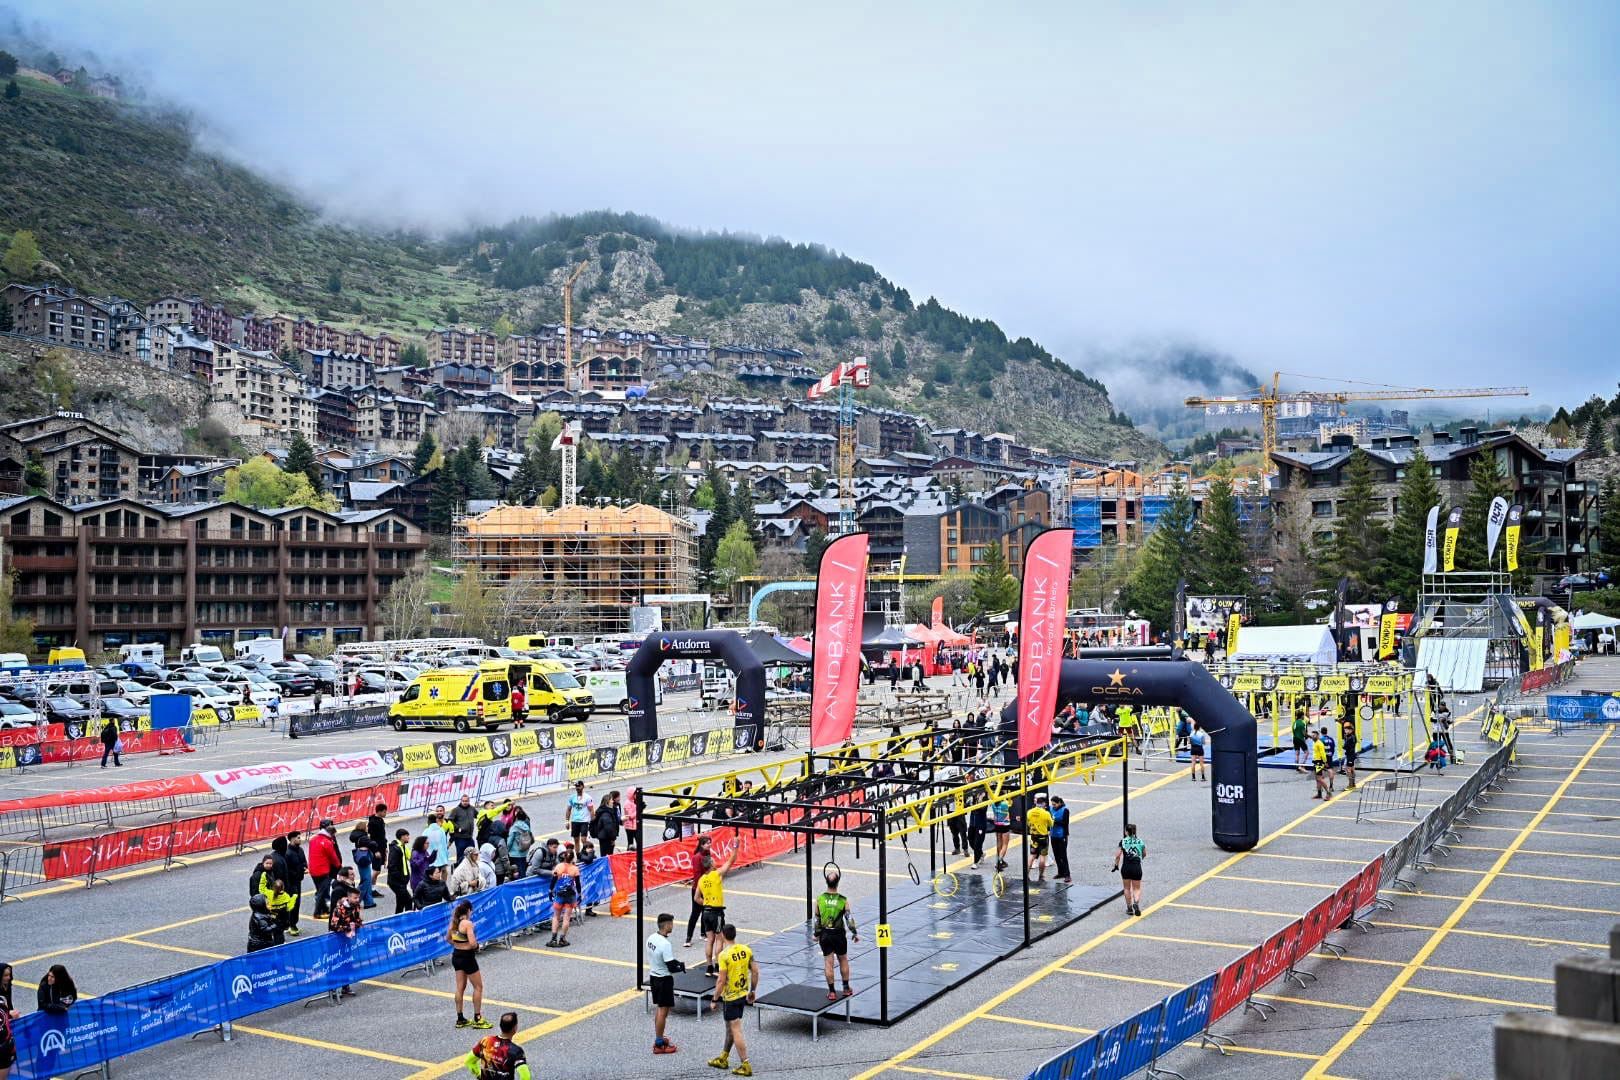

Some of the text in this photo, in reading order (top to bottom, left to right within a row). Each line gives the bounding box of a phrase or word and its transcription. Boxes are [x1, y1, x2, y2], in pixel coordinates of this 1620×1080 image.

[57, 411, 84, 419] HOTEL
[1491, 501, 1503, 524] OCR
[1444, 535, 1453, 564] OLYMPUS
[848, 584, 857, 619] Bankers
[1047, 581, 1059, 655] Private Bankers
[1382, 620, 1392, 650] OLYMPUS
[671, 639, 720, 650] Andorra
[825, 582, 845, 719] ANDBANK
[1026, 577, 1048, 726] ANDBANK
[1091, 686, 1144, 695] OCRA
[513, 736, 536, 747] OLYMPUS
[556, 729, 583, 739] OLYMPUS
[405, 750, 432, 761] OLYMPUS
[459, 742, 487, 754] OLYMPUS
[310, 756, 379, 770] urban
[215, 764, 293, 785] urban
[1216, 783, 1244, 799] OCR
[878, 929, 889, 938] 21
[731, 950, 747, 962] 619
[65, 1020, 99, 1035] Financera
[66, 1024, 118, 1046] d'Assegurances
